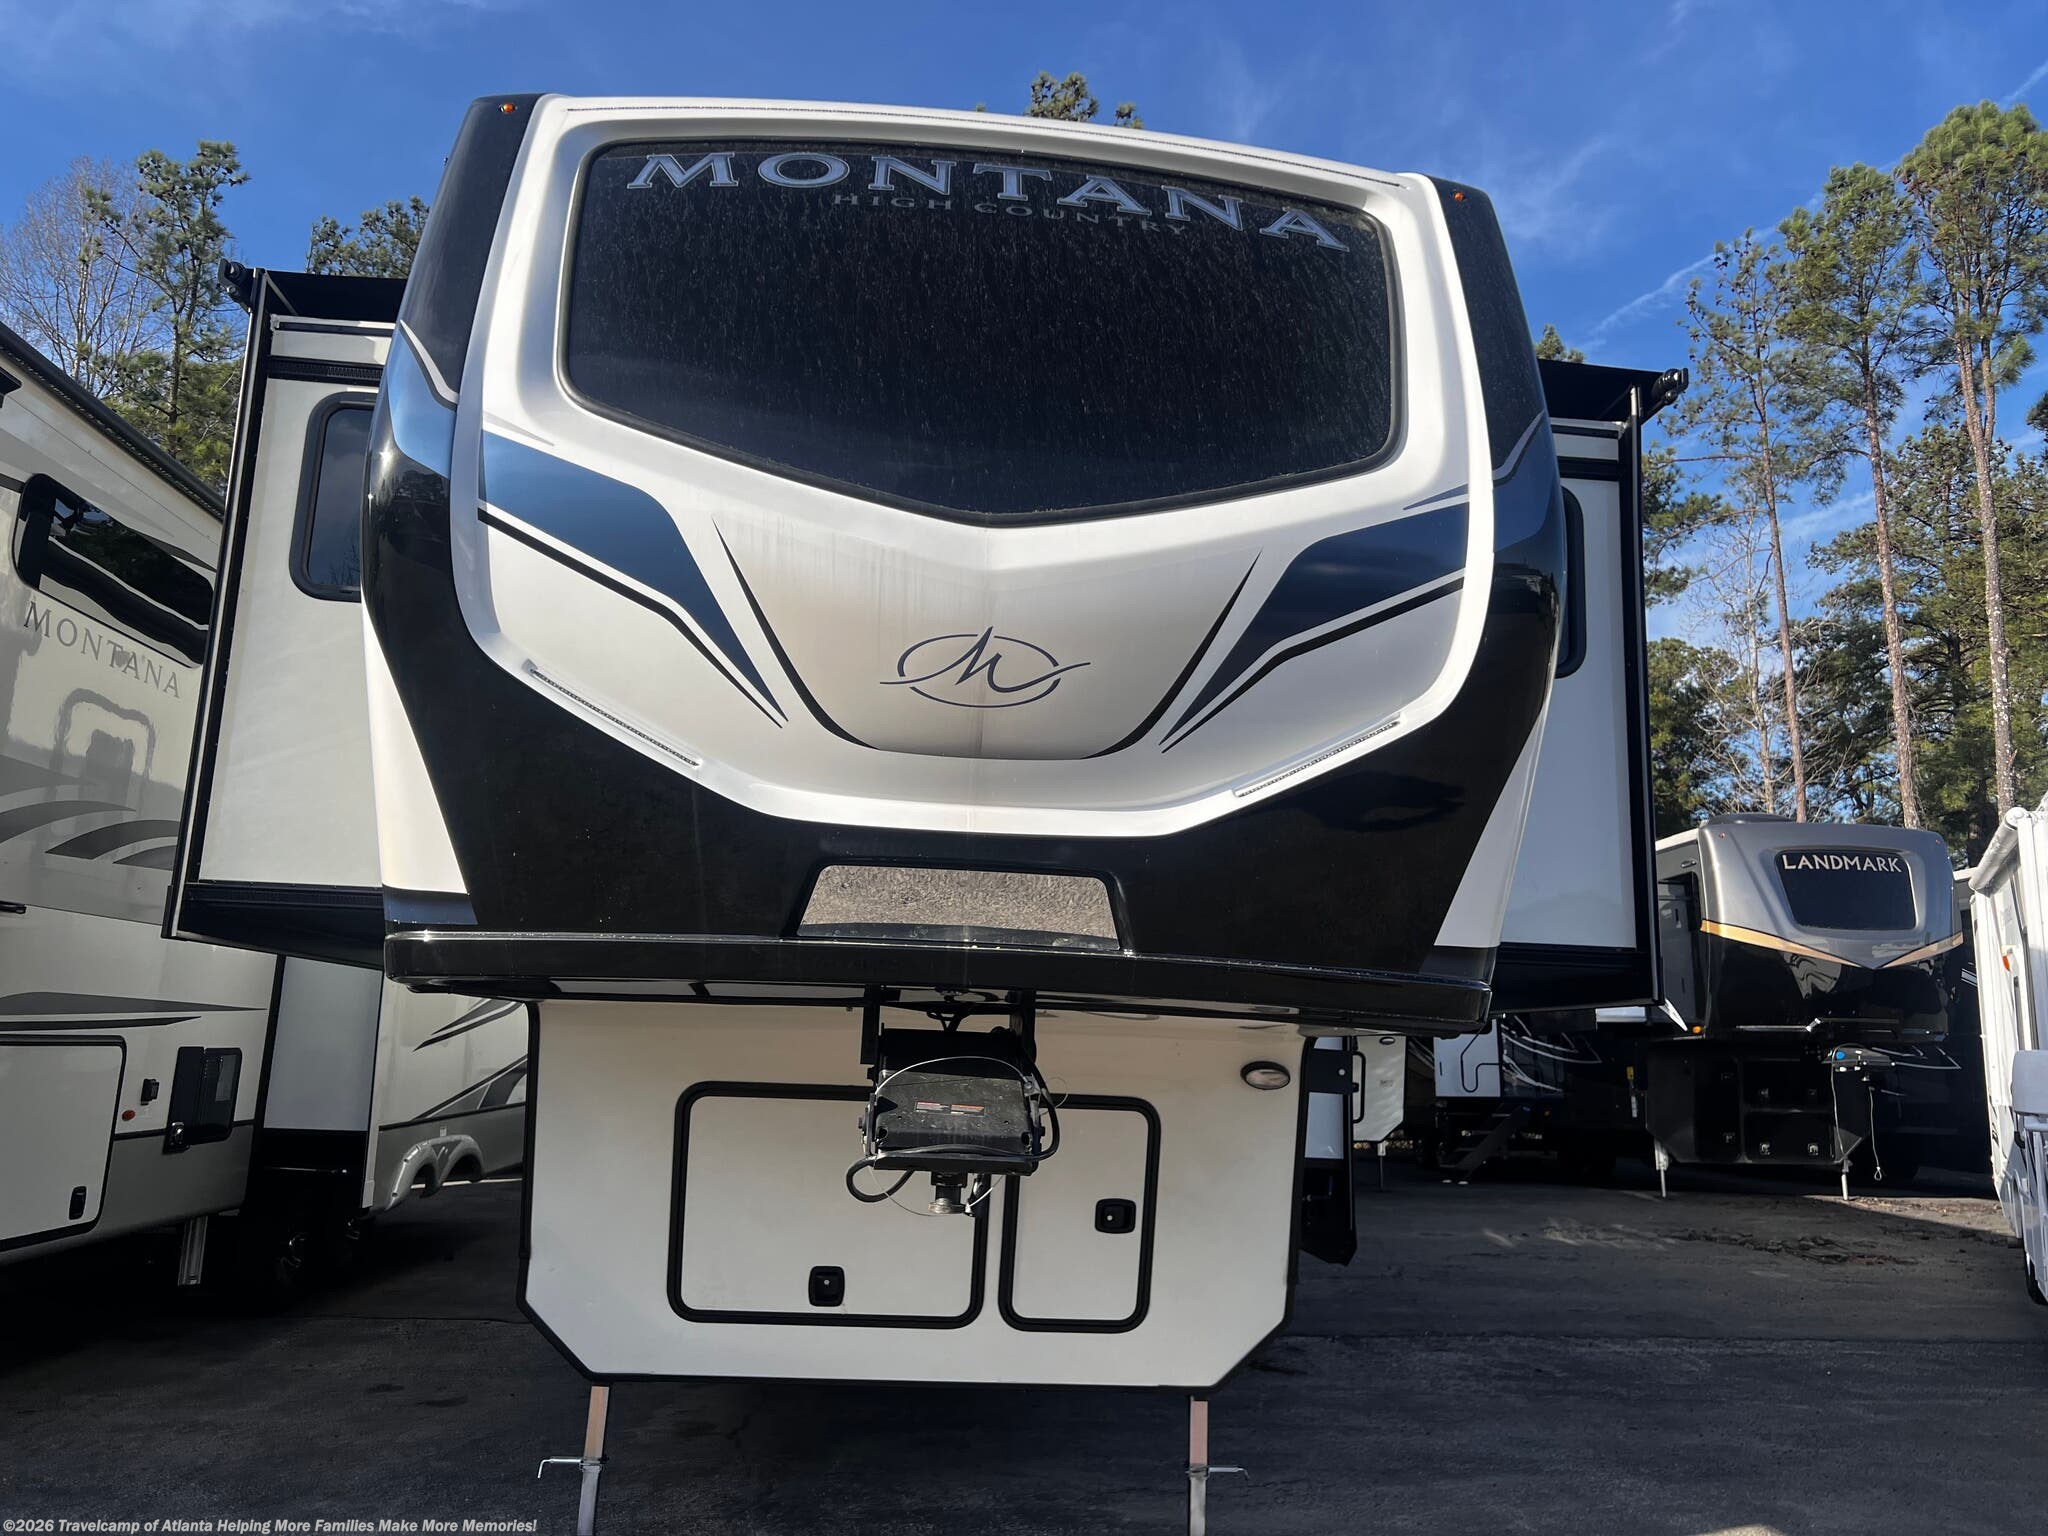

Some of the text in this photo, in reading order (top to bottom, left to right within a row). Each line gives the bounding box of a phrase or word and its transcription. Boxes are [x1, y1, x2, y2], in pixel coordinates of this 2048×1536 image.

[626, 152, 1349, 252] MONTANA
[834, 194, 951, 209] HIGH
[23, 600, 180, 698] MONTANA
[1782, 854, 1902, 872] LANDMARK
